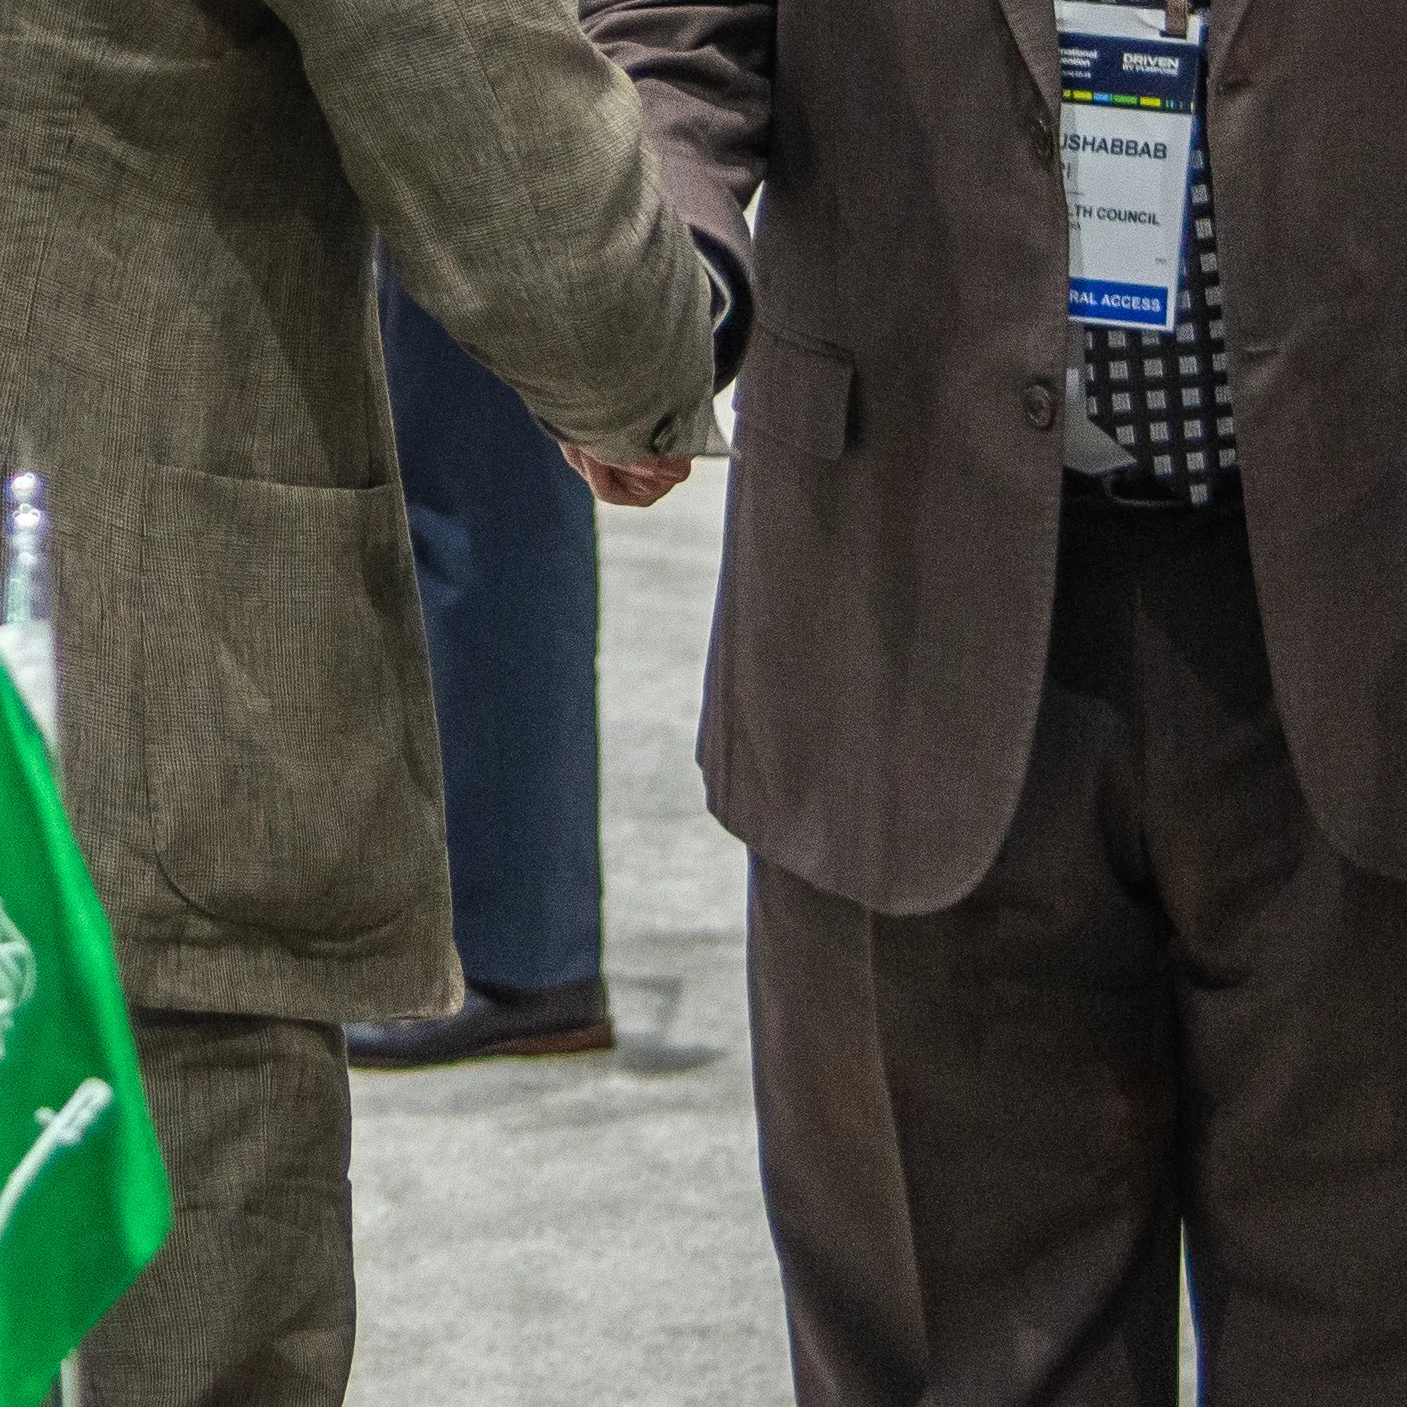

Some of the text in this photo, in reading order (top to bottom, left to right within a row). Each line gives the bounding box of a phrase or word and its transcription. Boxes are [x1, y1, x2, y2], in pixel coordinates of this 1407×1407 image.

[1123, 52, 1180, 69] DRIVEN
[1096, 206, 1160, 226] COUNCIL
[1101, 294, 1161, 313] ACCESS
